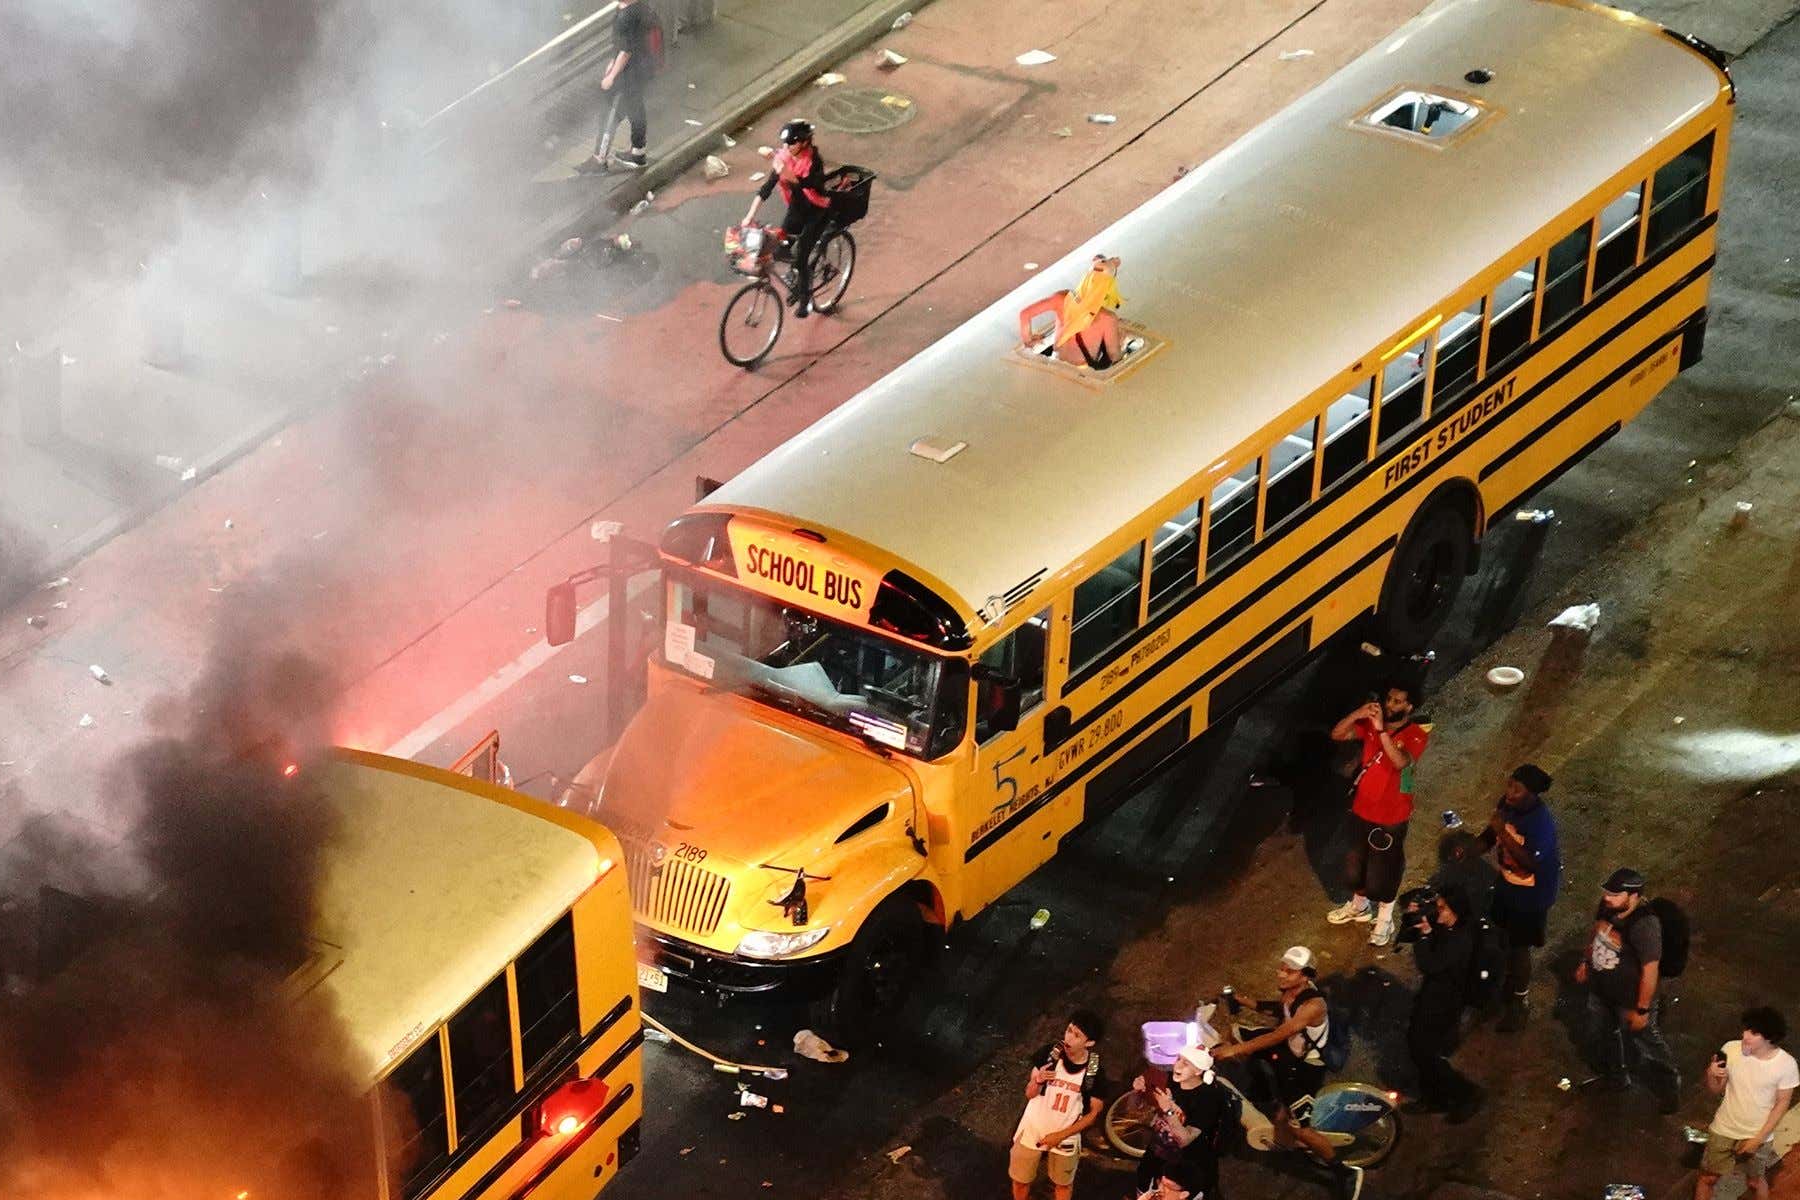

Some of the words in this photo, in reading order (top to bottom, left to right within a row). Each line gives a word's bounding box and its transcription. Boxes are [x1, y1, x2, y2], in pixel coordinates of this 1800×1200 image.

[1384, 437, 1433, 490] FIRST
[1436, 375, 1518, 451] STUDENT
[746, 543, 819, 596] SCHOOL
[824, 570, 862, 609] BUS
[1058, 737, 1085, 770] GVWR
[991, 746, 1027, 813] 5
[675, 842, 708, 864] 2189
[1051, 1092, 1070, 1113] 11
